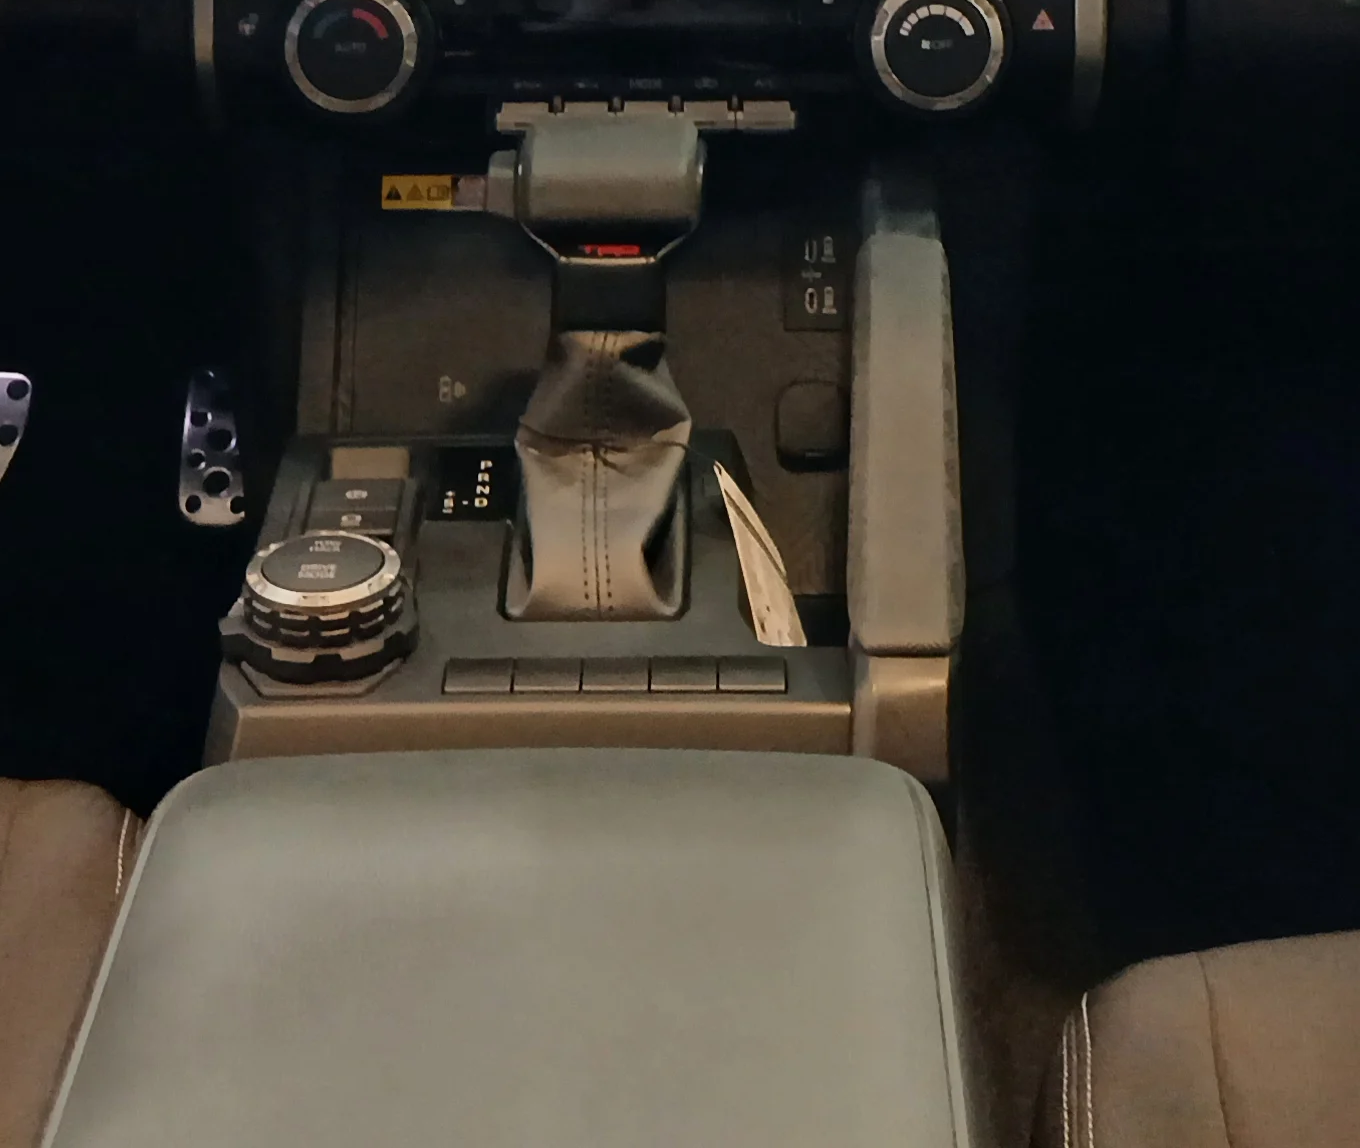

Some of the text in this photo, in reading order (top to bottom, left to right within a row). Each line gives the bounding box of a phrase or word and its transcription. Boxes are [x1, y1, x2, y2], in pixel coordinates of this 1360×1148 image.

[480, 460, 493, 470] P
[476, 485, 490, 495] N
[474, 497, 488, 508] D
